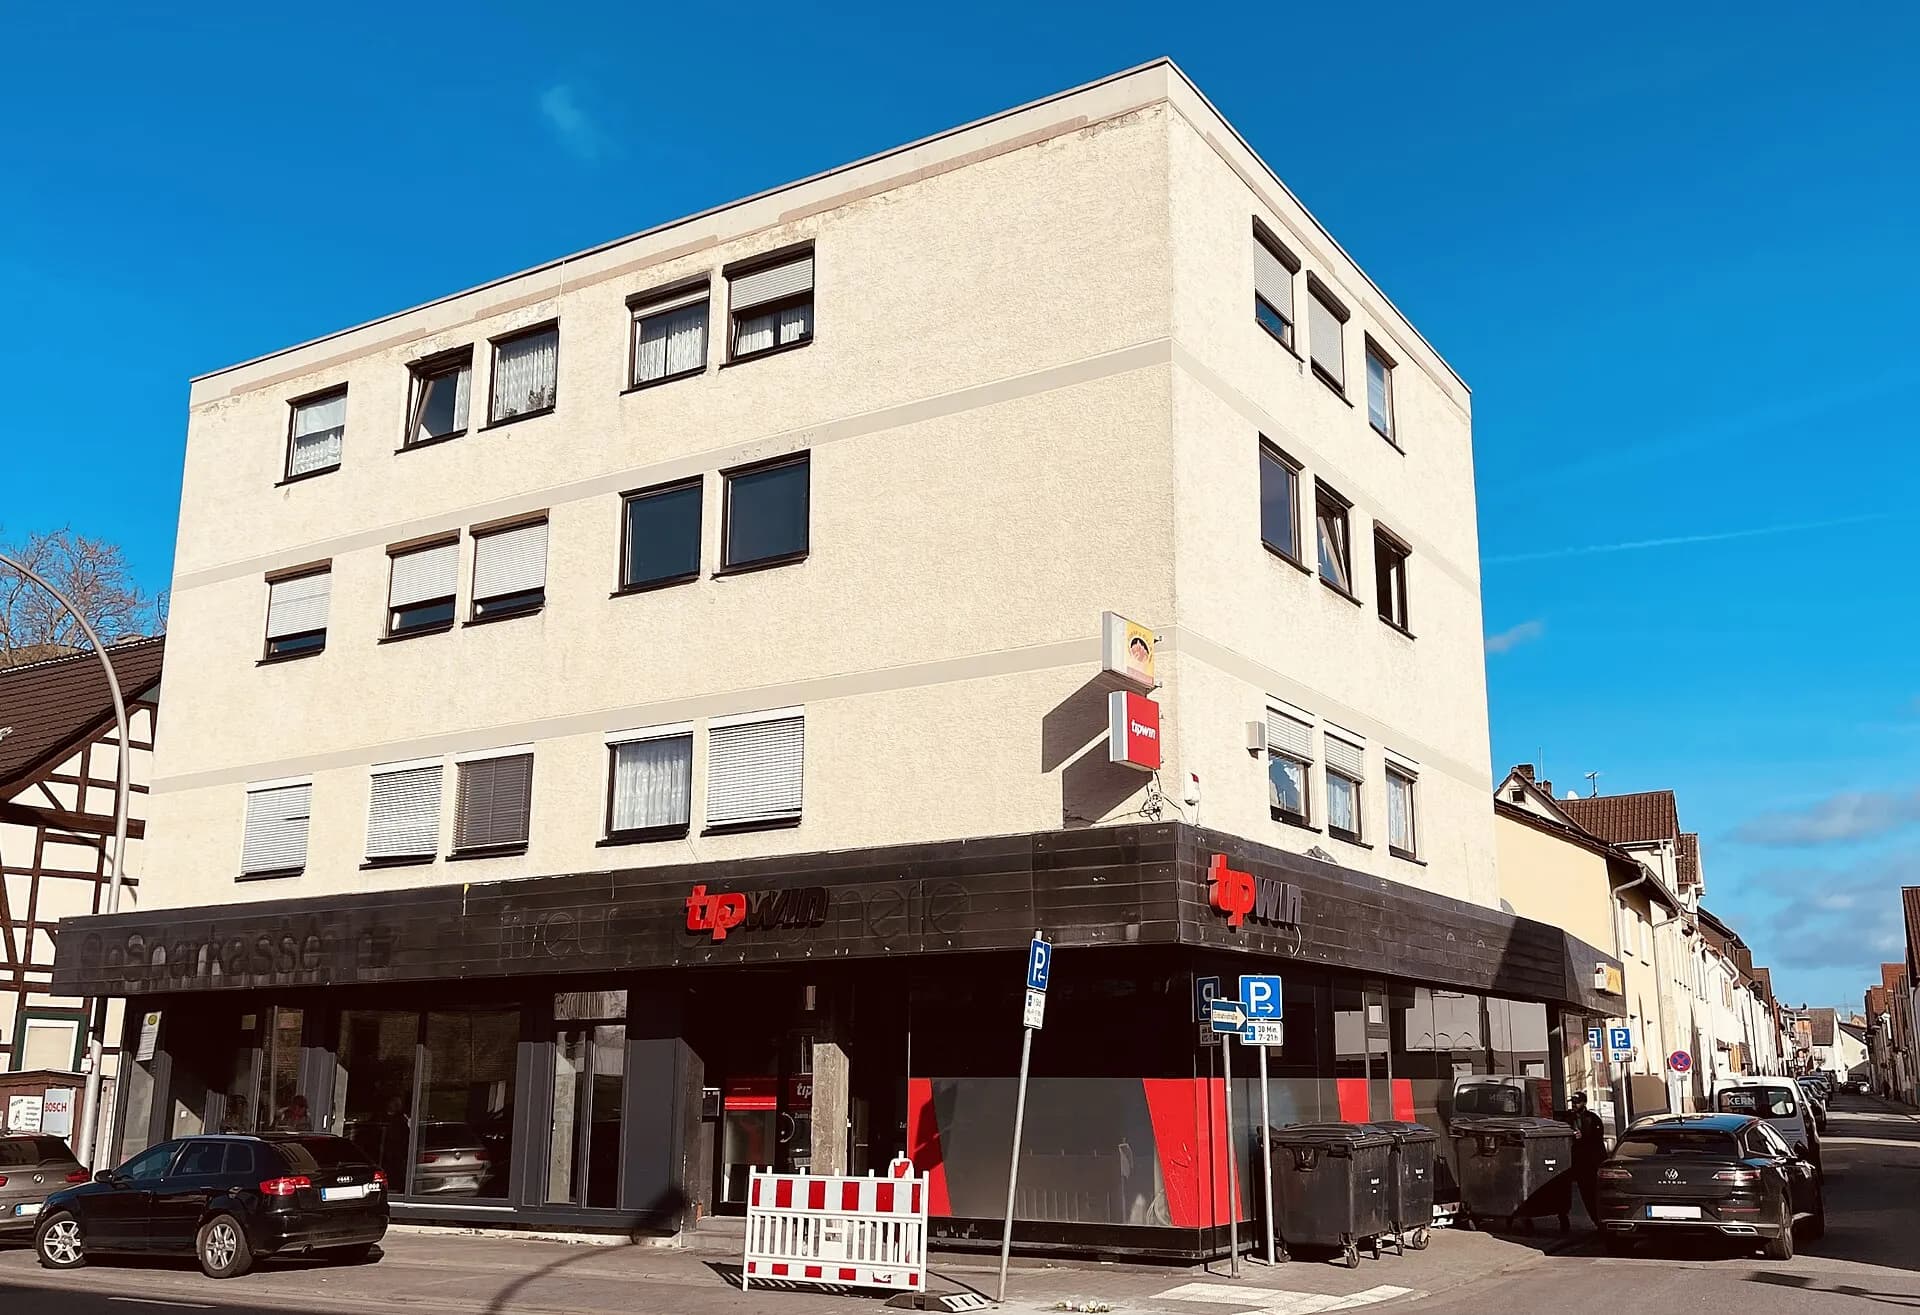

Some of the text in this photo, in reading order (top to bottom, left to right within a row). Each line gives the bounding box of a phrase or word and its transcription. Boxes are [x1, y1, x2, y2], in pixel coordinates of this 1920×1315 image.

[1131, 719, 1156, 740] tipwin
[1208, 854, 1301, 928] tipwin
[687, 885, 827, 940] tipwin
[1033, 946, 1046, 981] P
[1249, 981, 1272, 1013] P
[1614, 1031, 1626, 1048] P
[45, 1102, 67, 1113] BOSCH
[1727, 1096, 1756, 1106] KERN
